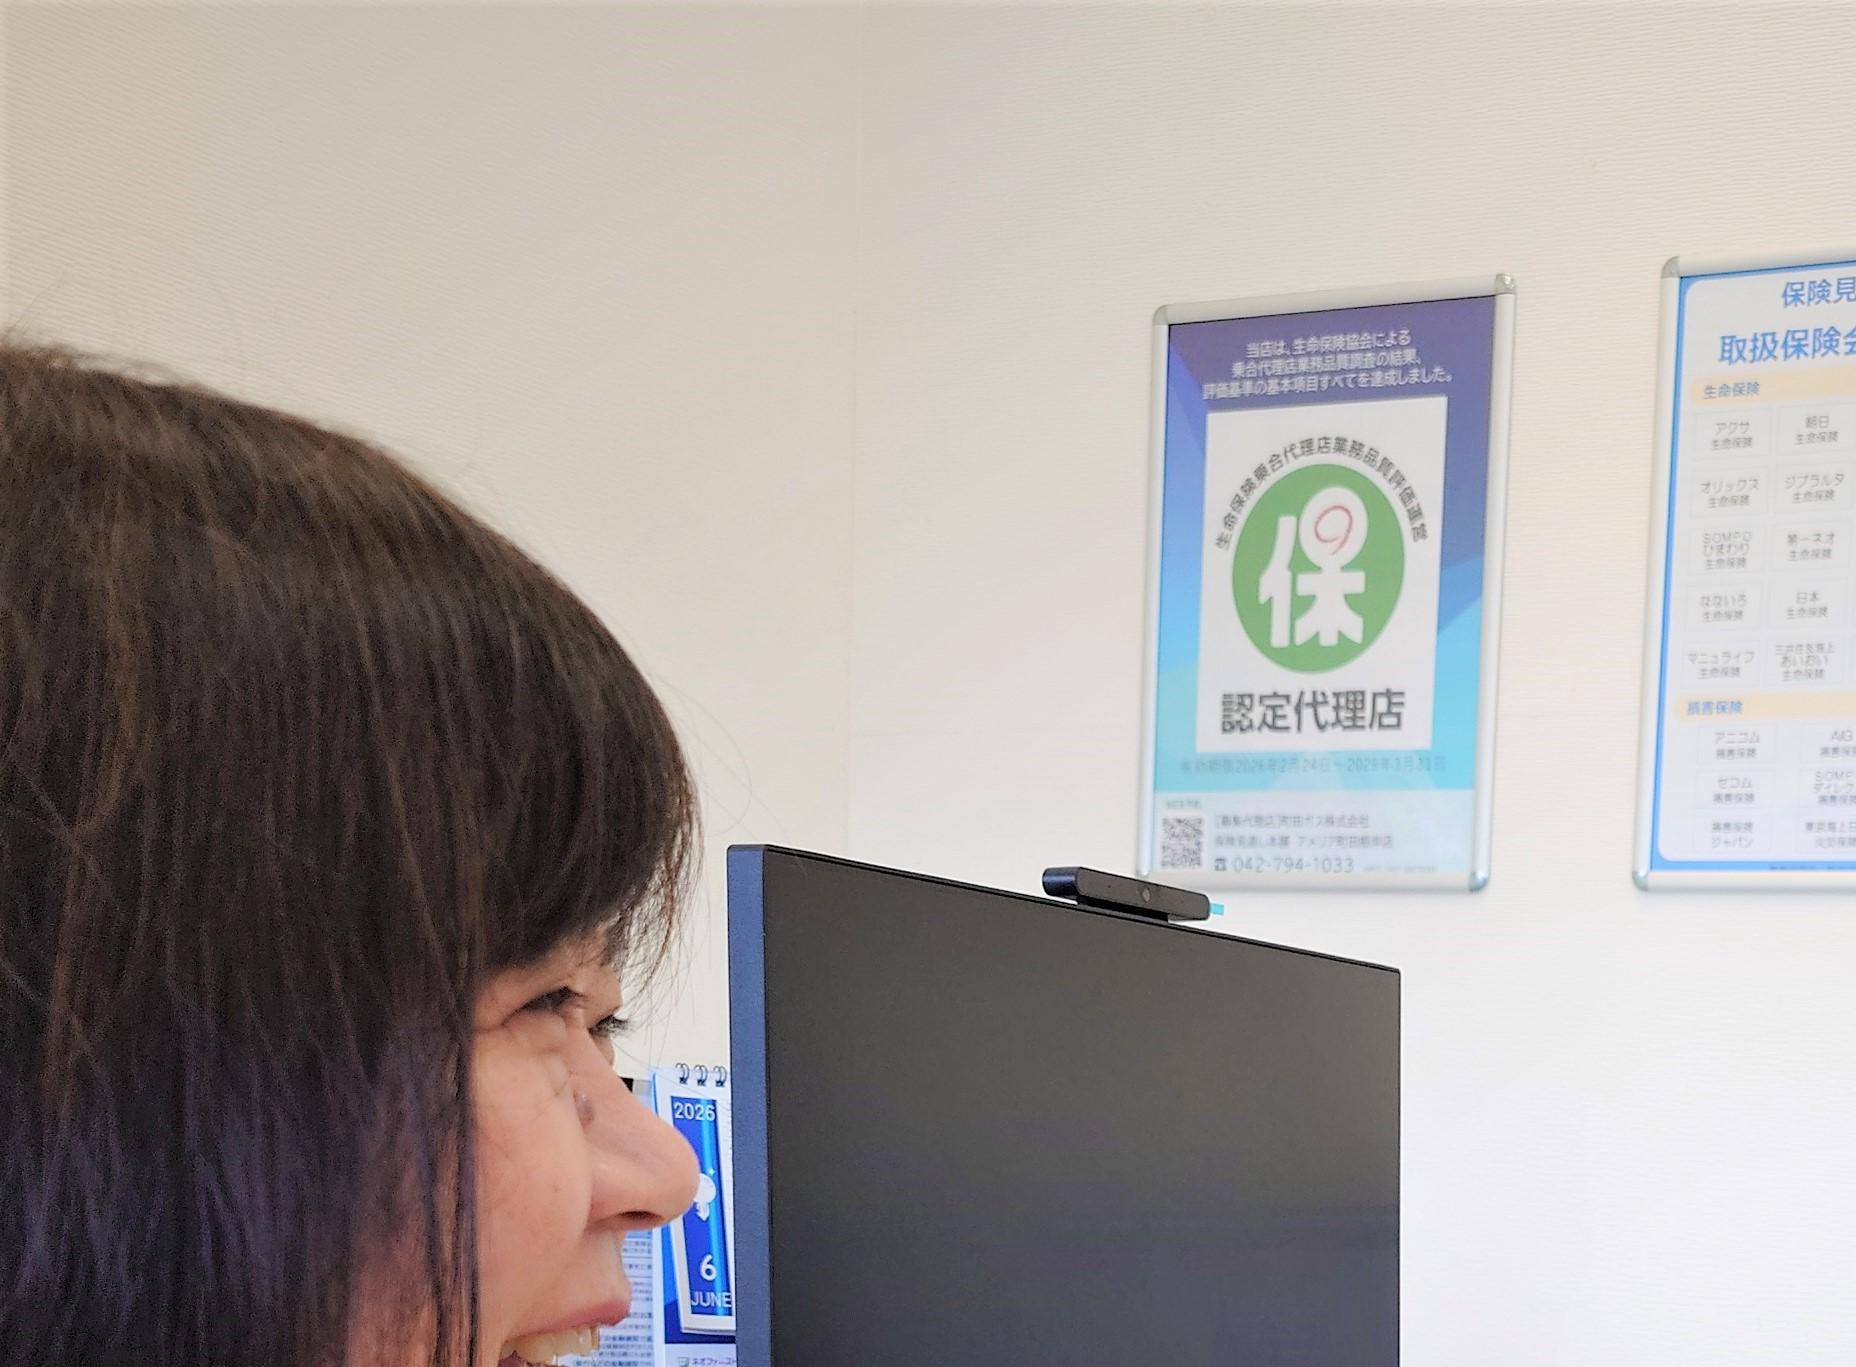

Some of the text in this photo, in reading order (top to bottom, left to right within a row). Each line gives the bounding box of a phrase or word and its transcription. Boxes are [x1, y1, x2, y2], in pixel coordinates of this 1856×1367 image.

[1704, 382, 1760, 399] 生命保険
[1716, 422, 1750, 434] アクサ
[1700, 479, 1760, 494] オリックス
[1785, 473, 1844, 489] ジブラルタ
[1221, 688, 1405, 734] 認定代理店
[1232, 856, 1354, 873] 042-794-1033
[674, 1102, 715, 1121] 2026
[700, 1254, 717, 1281] 6
[690, 1291, 732, 1309] JUNE
